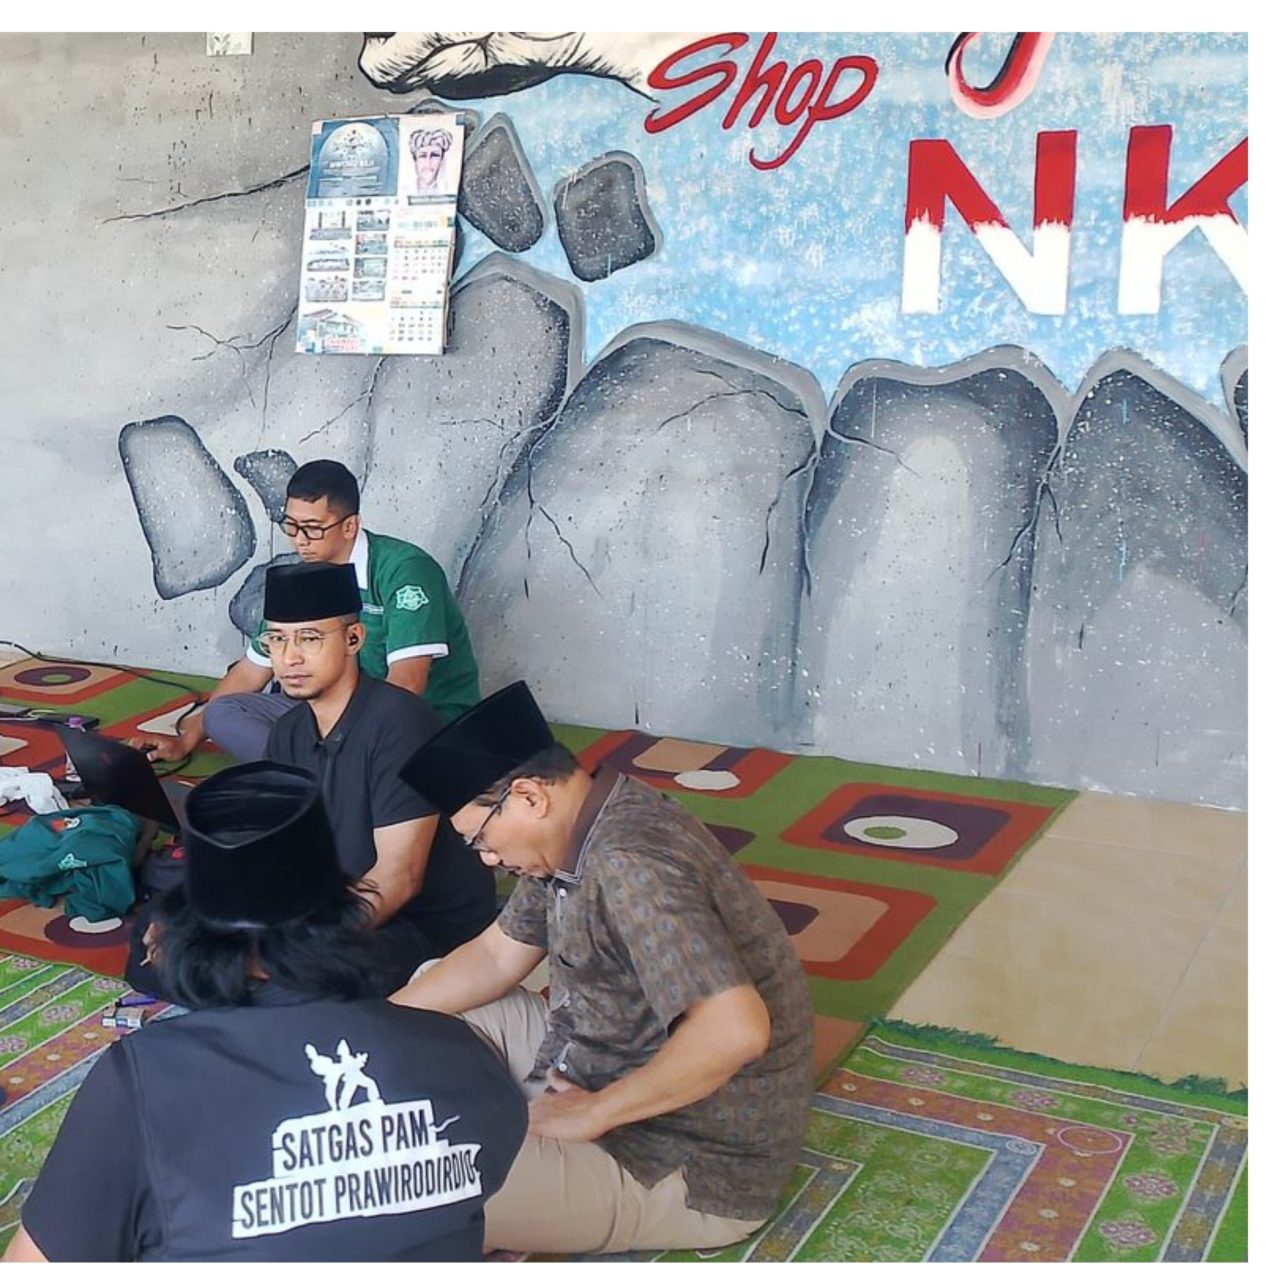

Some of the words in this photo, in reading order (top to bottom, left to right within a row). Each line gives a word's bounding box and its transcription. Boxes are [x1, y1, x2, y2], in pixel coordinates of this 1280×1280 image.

[645, 33, 879, 170] Shop
[901, 124, 1249, 315] NK
[281, 1118, 374, 1171] SATGAS
[380, 1109, 430, 1153] PAM
[240, 1178, 327, 1230] SENTOT
